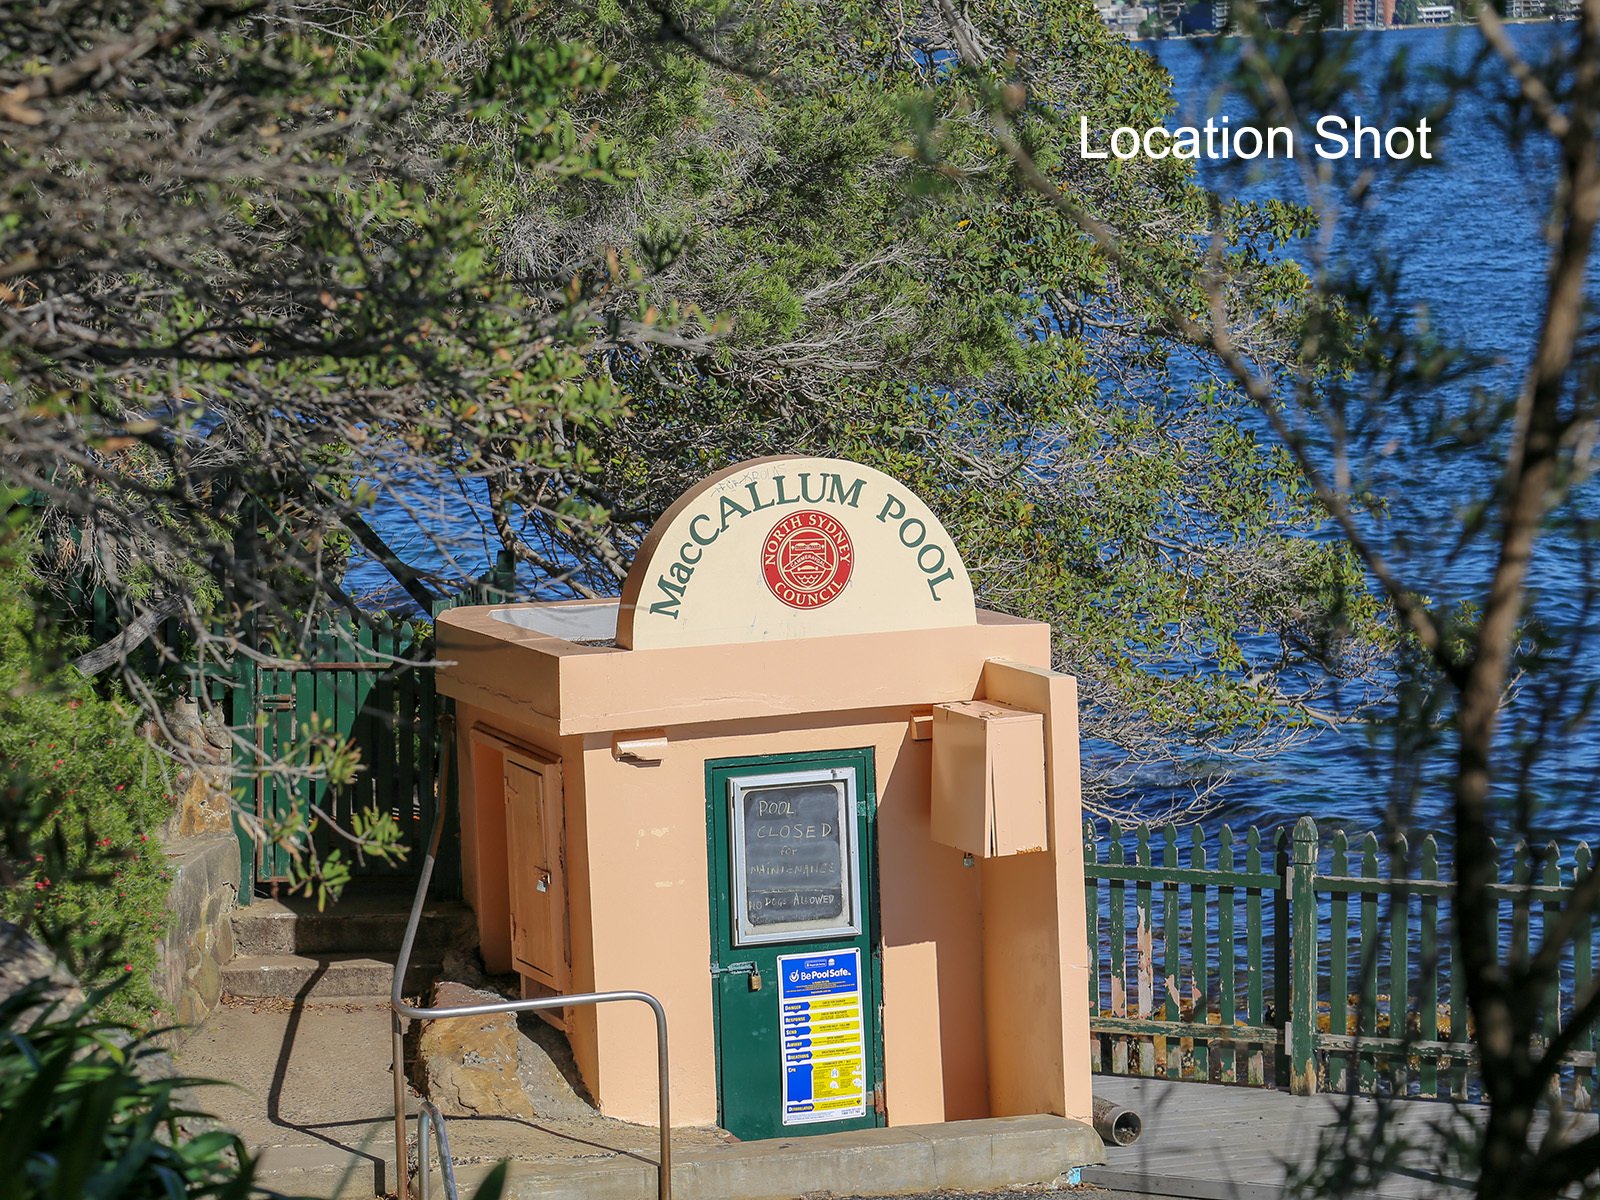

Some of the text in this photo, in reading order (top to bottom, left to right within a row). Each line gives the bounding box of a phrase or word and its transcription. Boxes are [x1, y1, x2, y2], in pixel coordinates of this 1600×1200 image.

[649, 472, 955, 620] MacCALLUM POOL
[765, 514, 851, 565] NORTH SYDNEY
[774, 580, 843, 605] COUNCIL
[759, 800, 795, 817] POOL
[756, 823, 832, 838] CLOSED
